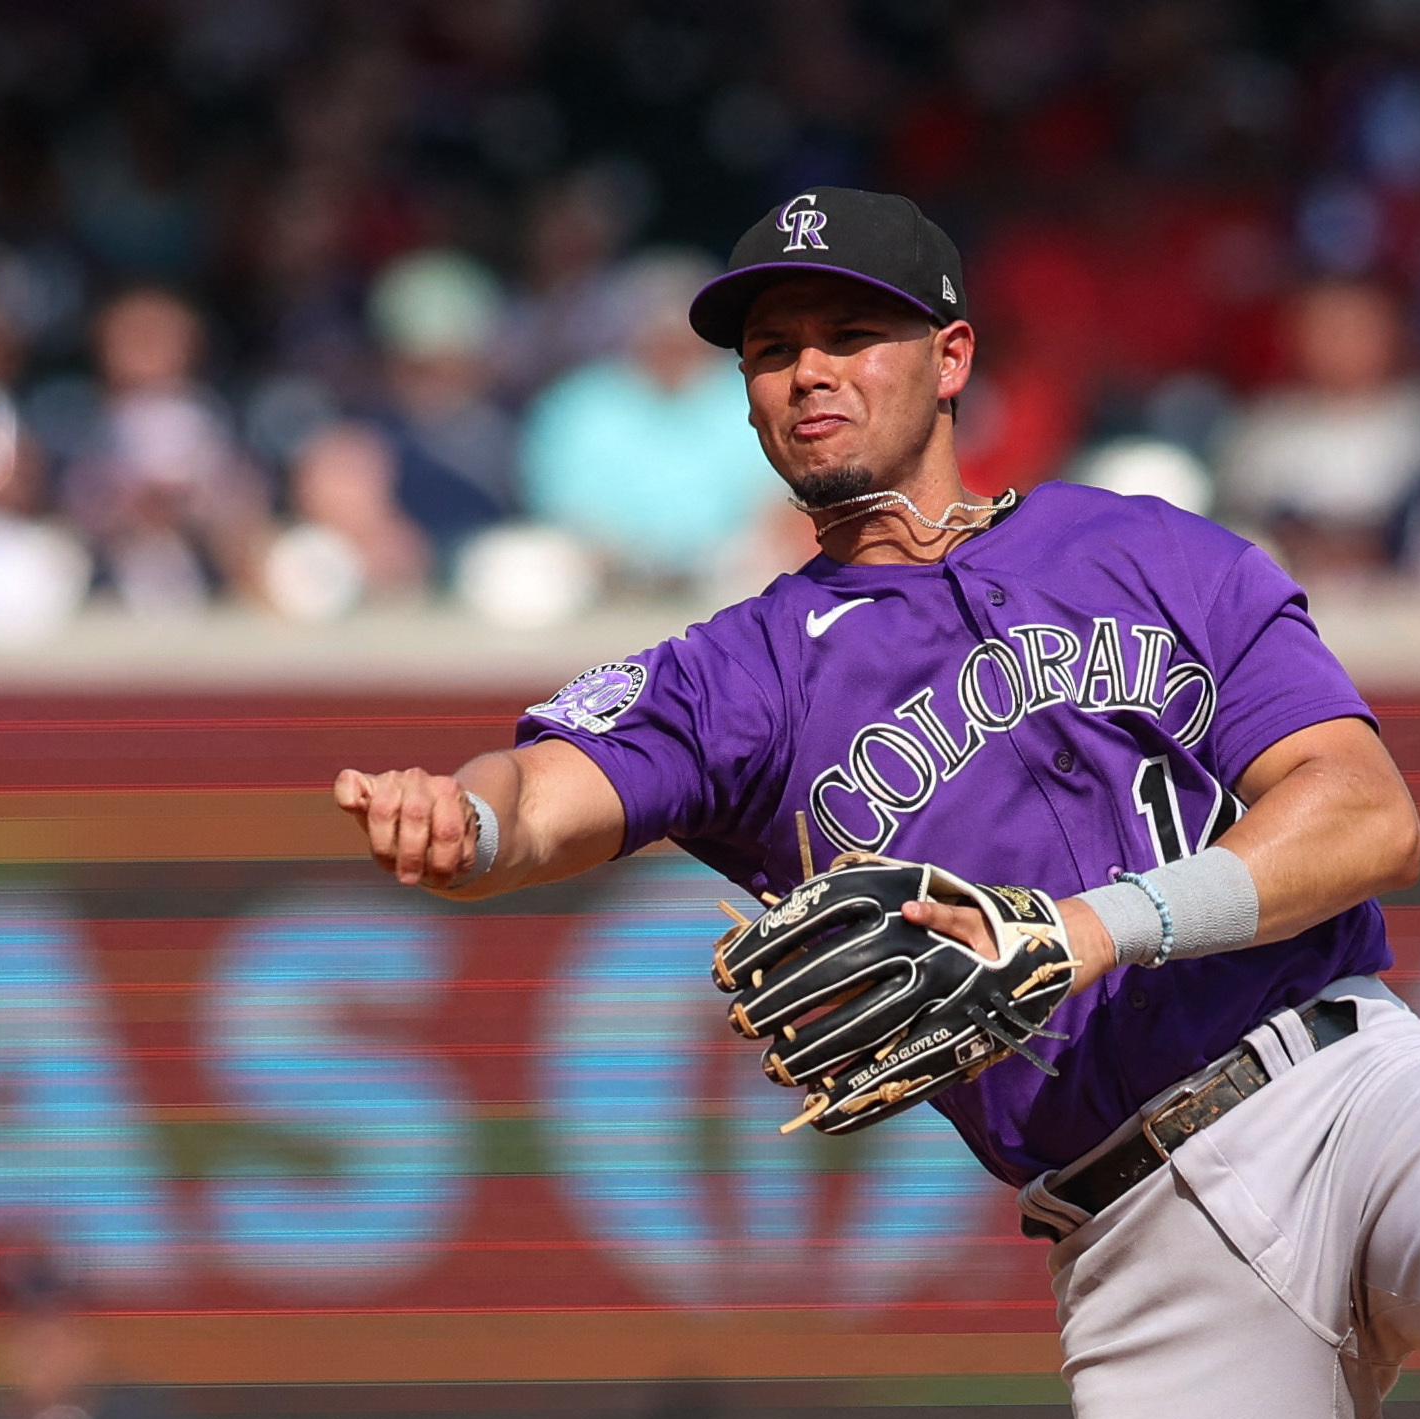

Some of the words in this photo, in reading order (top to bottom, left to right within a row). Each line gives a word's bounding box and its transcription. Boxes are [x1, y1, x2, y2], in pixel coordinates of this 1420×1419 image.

[775, 194, 829, 253] CR
[809, 617, 1217, 856] COLORADO
[759, 881, 831, 938] Rawlings
[848, 1069, 873, 1090] THE
[898, 1036, 935, 1061] GLOVE
[931, 1027, 952, 1043] CO.
